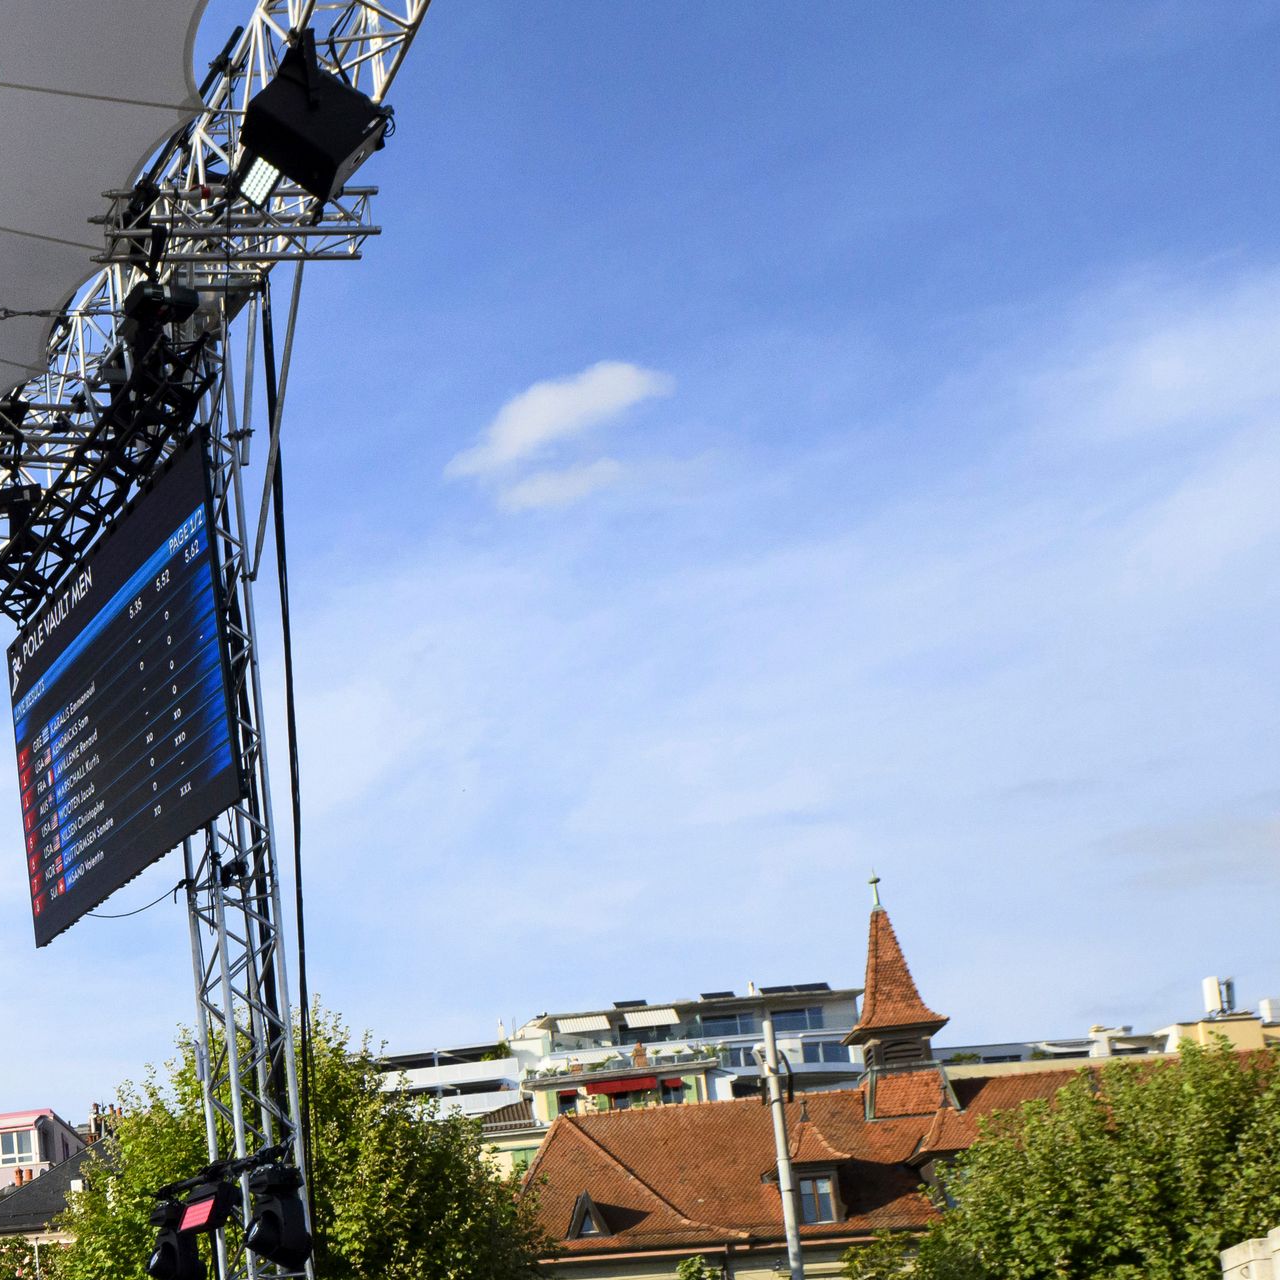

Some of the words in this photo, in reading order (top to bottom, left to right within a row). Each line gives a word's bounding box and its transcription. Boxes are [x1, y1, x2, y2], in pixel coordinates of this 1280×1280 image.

[169, 523, 188, 555] PAGE
[188, 507, 202, 536] 1/2
[22, 623, 43, 664] POLE
[43, 592, 70, 640] VAULT
[70, 565, 92, 608] MEN
[129, 596, 142, 621] 5.35
[155, 567, 169, 593] 5.52
[184, 538, 199, 565] 5.62
